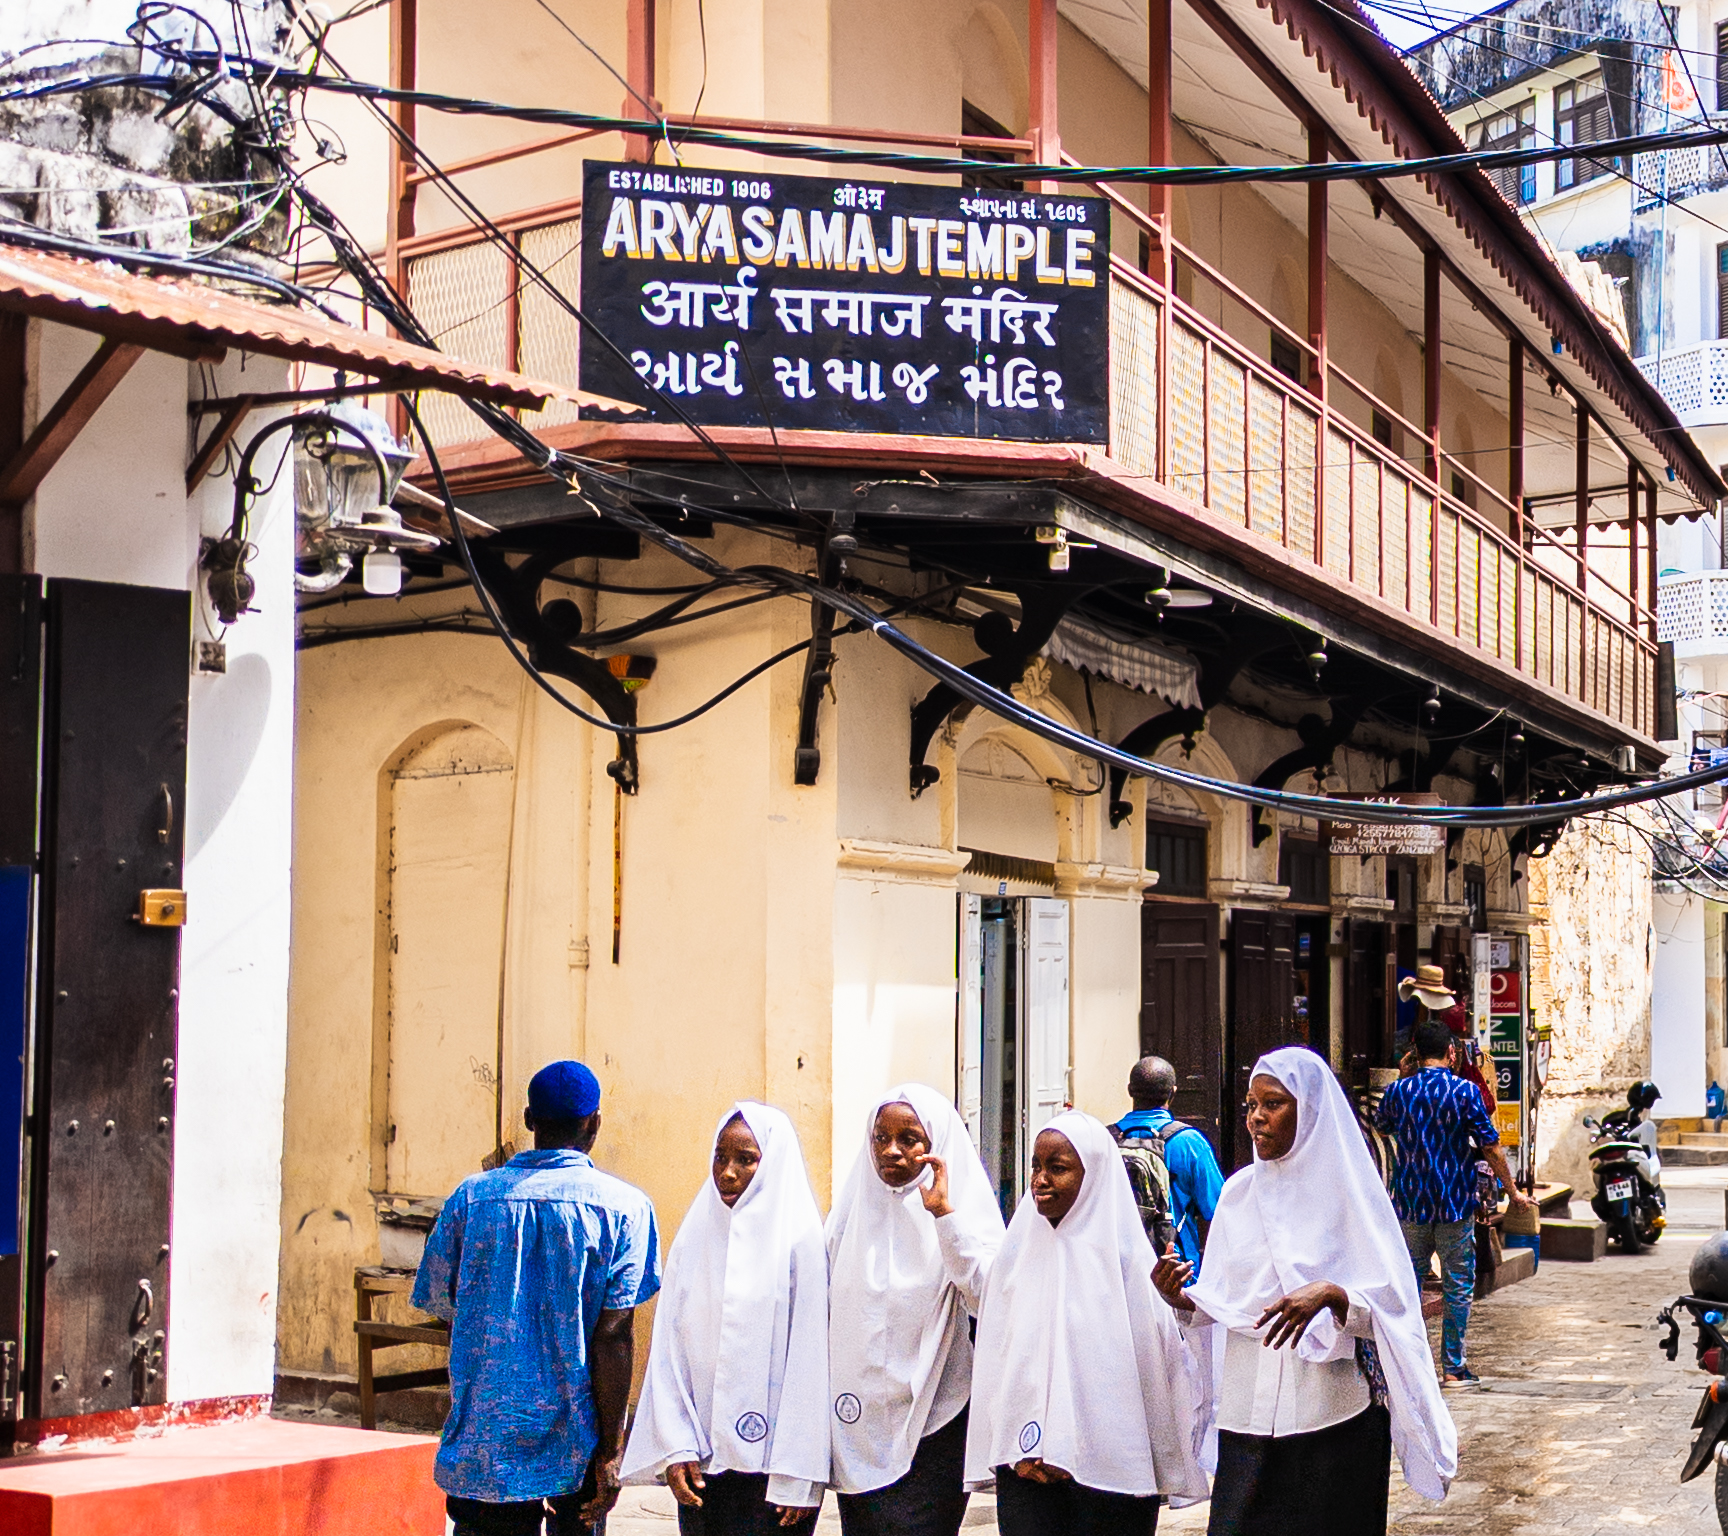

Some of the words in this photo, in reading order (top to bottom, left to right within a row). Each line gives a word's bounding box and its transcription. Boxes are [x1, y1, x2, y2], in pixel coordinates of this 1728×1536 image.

[609, 170, 724, 197] ESTABLISHED
[732, 179, 772, 200] 1906
[602, 196, 741, 265] ARYA
[741, 206, 908, 275] SAMAJ
[908, 216, 1096, 288] TEMPLE
[640, 265, 759, 331] आर्य
[769, 287, 932, 339] समाज
[940, 285, 1060, 347] मंदिर
[630, 340, 744, 397] આર્ય
[959, 353, 1065, 411] મંદિર
